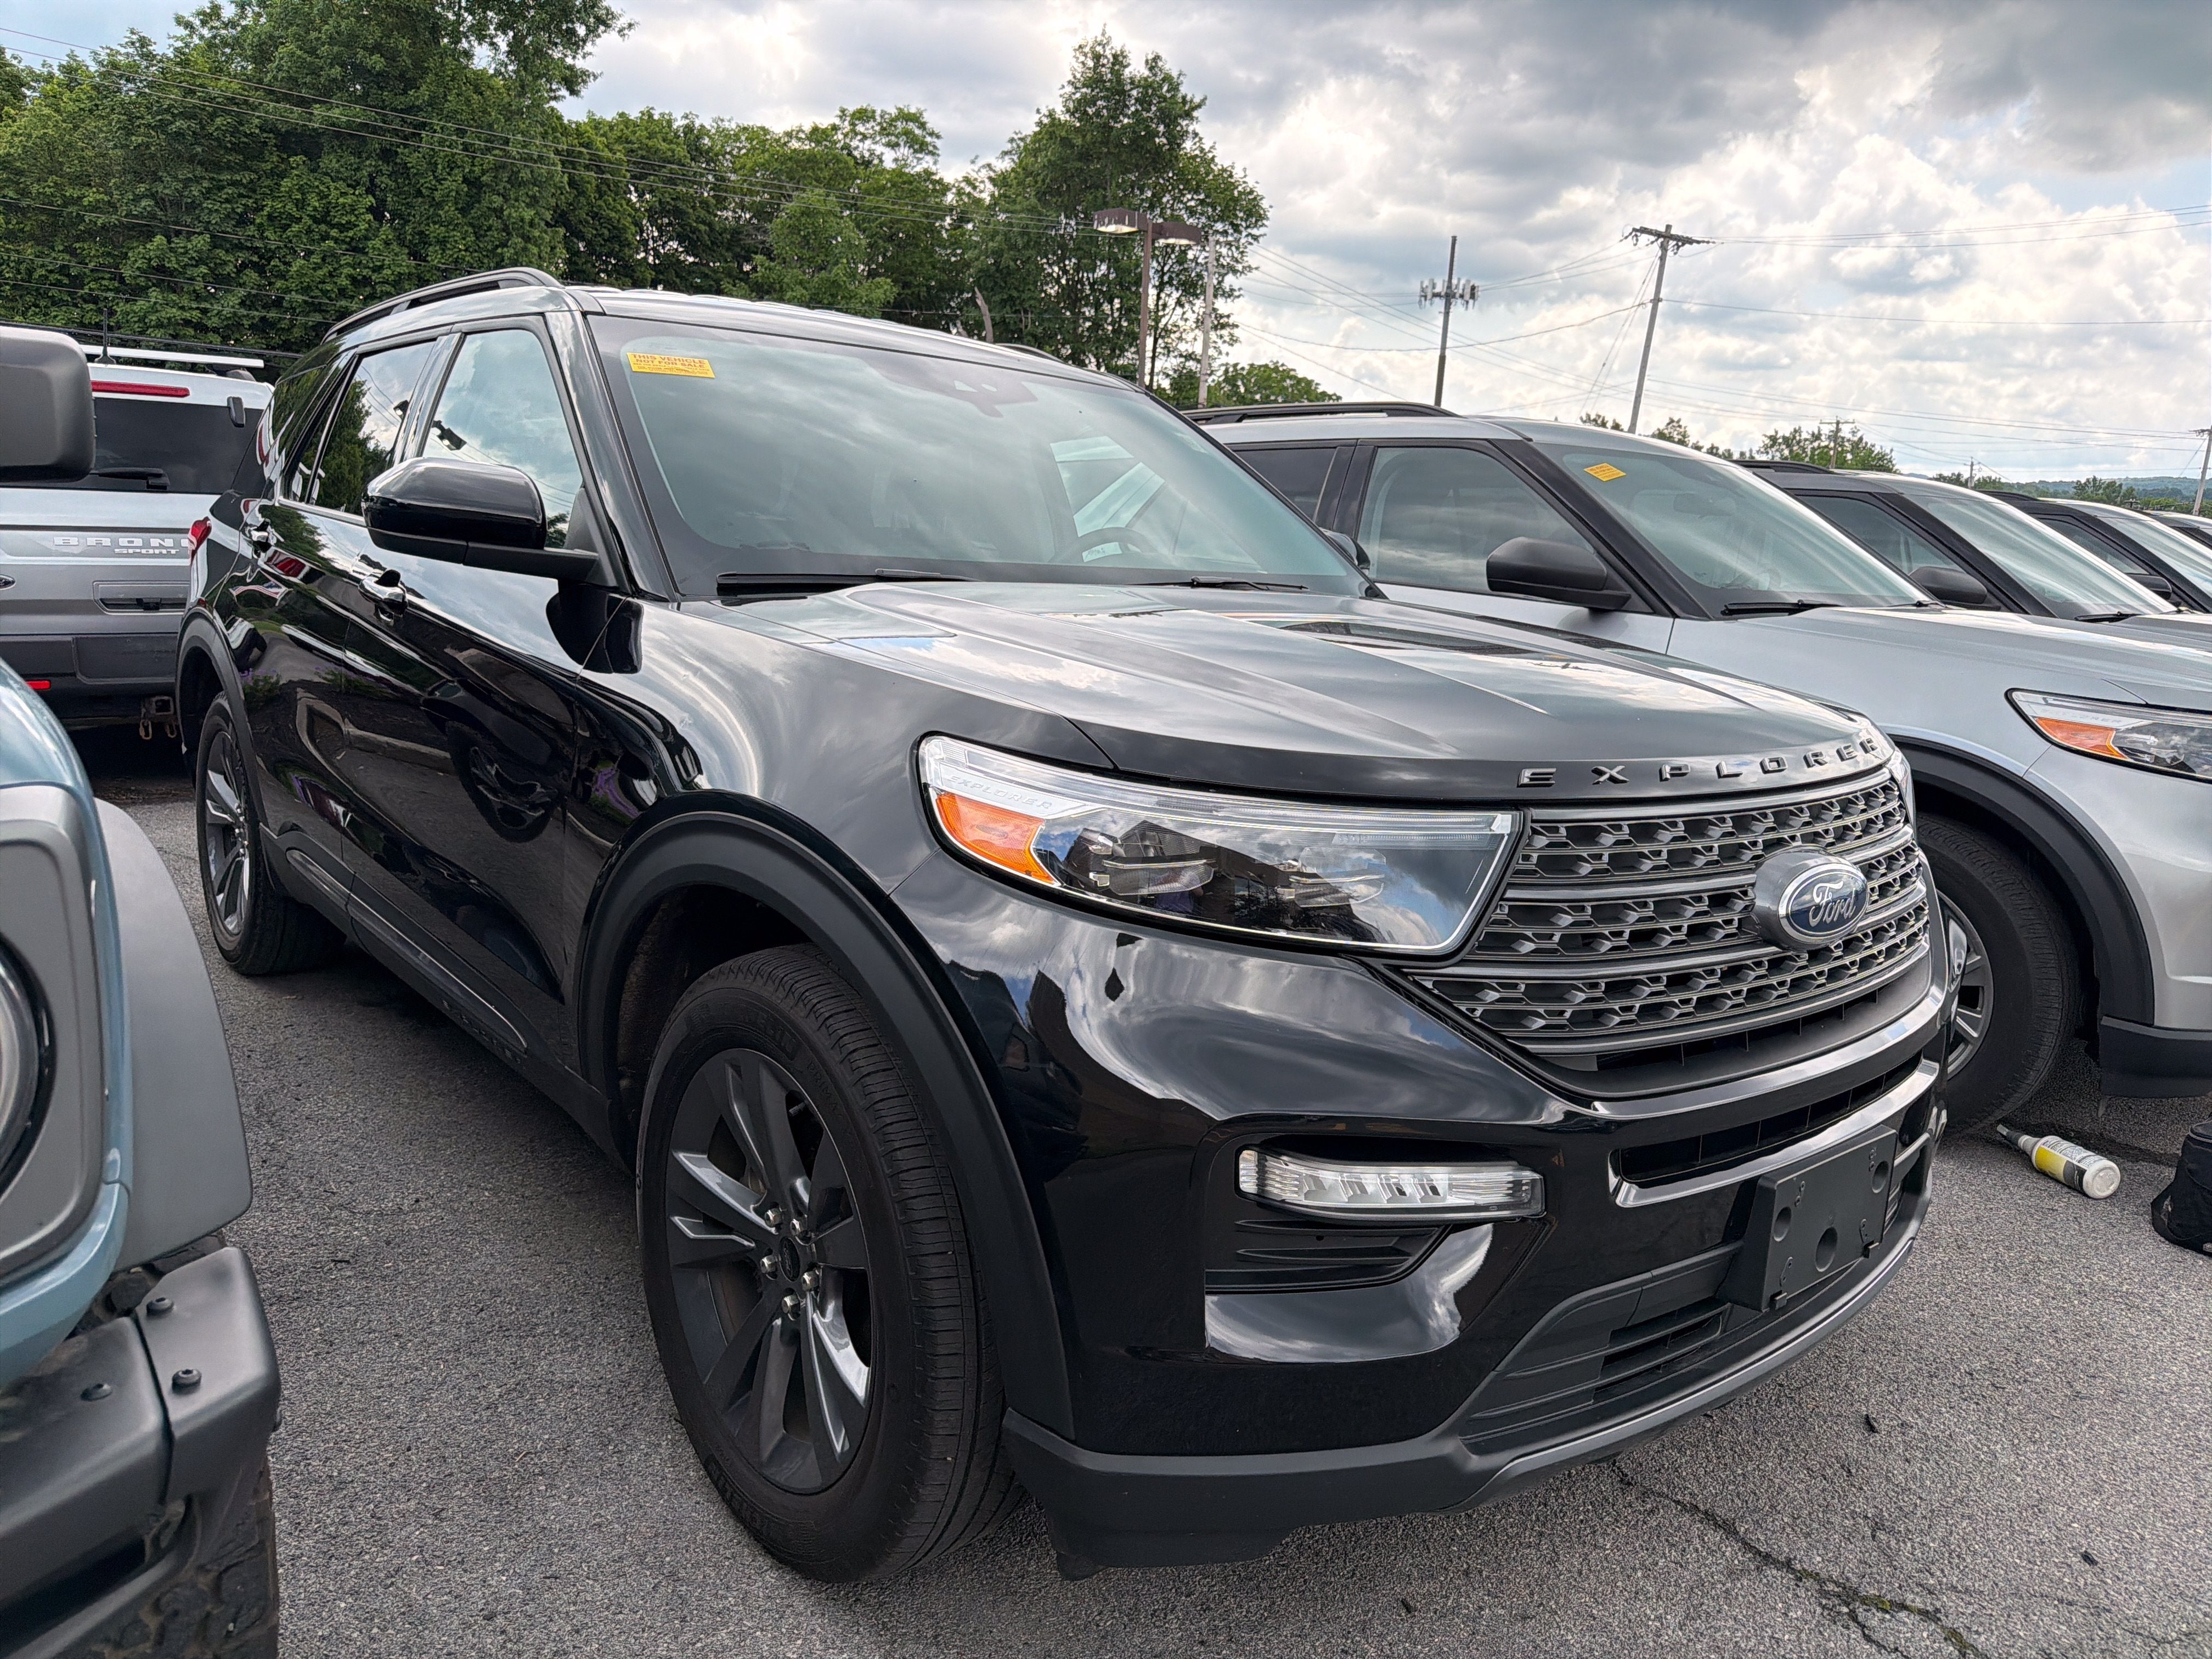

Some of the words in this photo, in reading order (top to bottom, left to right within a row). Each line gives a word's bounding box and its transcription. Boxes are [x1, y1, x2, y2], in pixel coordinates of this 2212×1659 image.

[659, 356, 706, 364] VEHICLE
[53, 537, 189, 547] BRON
[1517, 736, 1878, 787] EXPLORER
[947, 775, 1052, 809] EXPLORER
[1809, 881, 1857, 927] Ford
